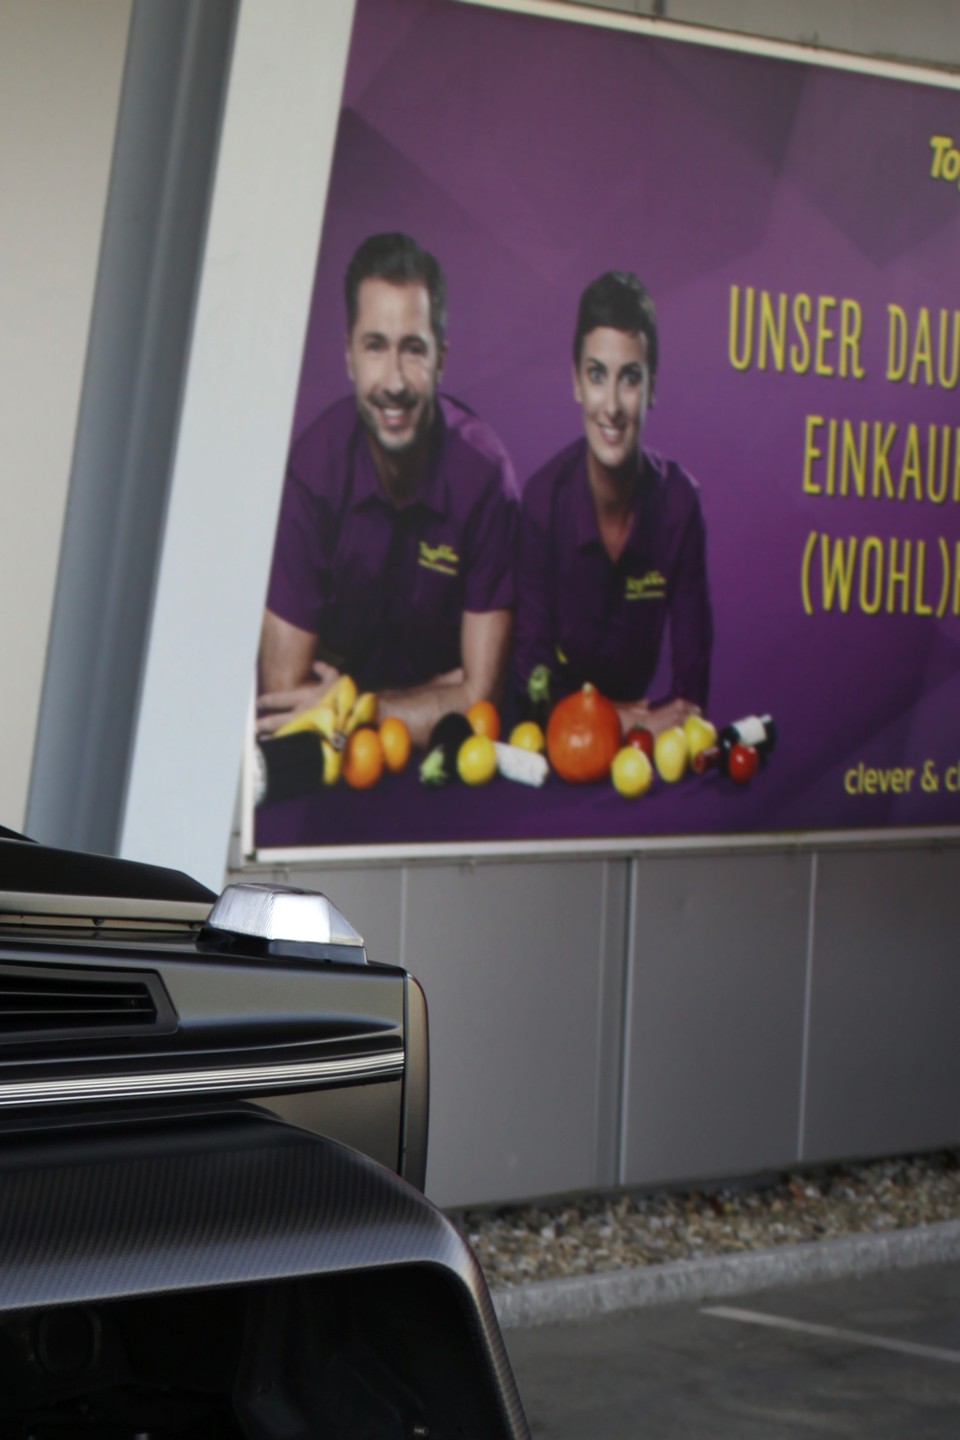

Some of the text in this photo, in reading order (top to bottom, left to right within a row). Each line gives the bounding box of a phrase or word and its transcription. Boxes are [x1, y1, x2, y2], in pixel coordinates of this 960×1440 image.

[930, 135, 960, 190] To
[729, 285, 960, 389] UNSER DAU
[844, 761, 916, 795] clever
[920, 759, 939, 792] &
